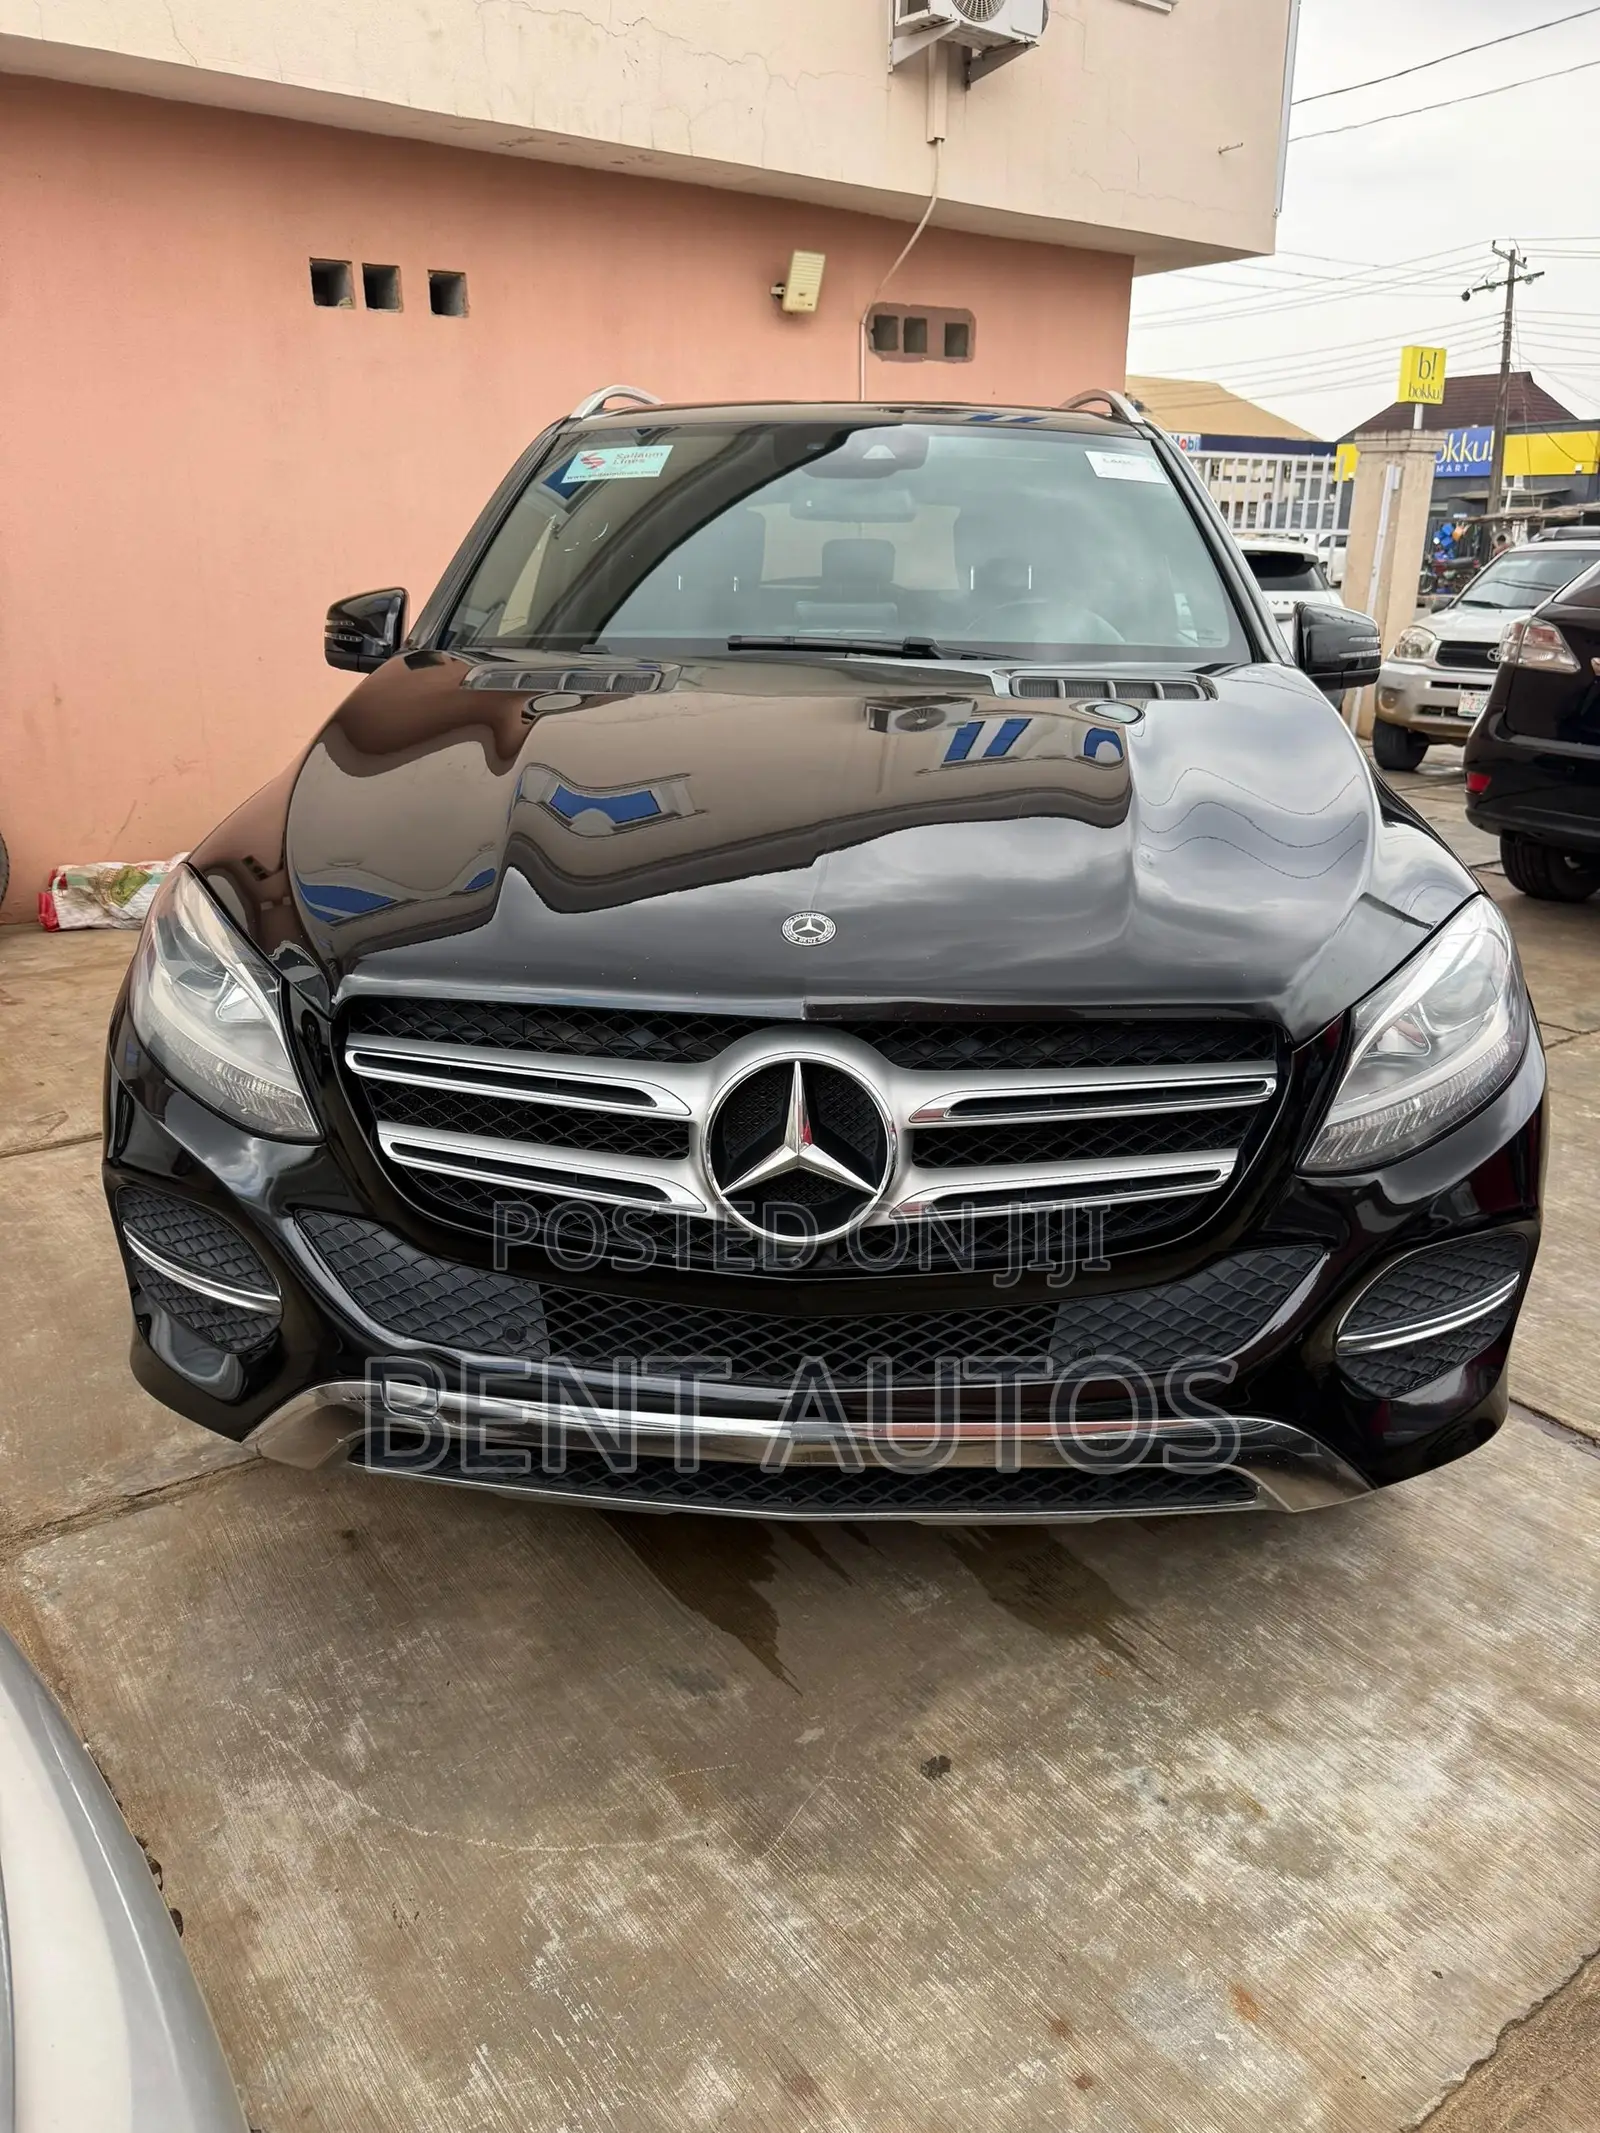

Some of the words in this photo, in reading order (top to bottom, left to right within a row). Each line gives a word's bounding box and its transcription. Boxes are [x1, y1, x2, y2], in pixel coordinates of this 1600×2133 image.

[1419, 351, 1437, 380] b!
[1408, 382, 1443, 401] bokku!
[1435, 430, 1495, 463] okku!
[1436, 463, 1469, 473] MART
